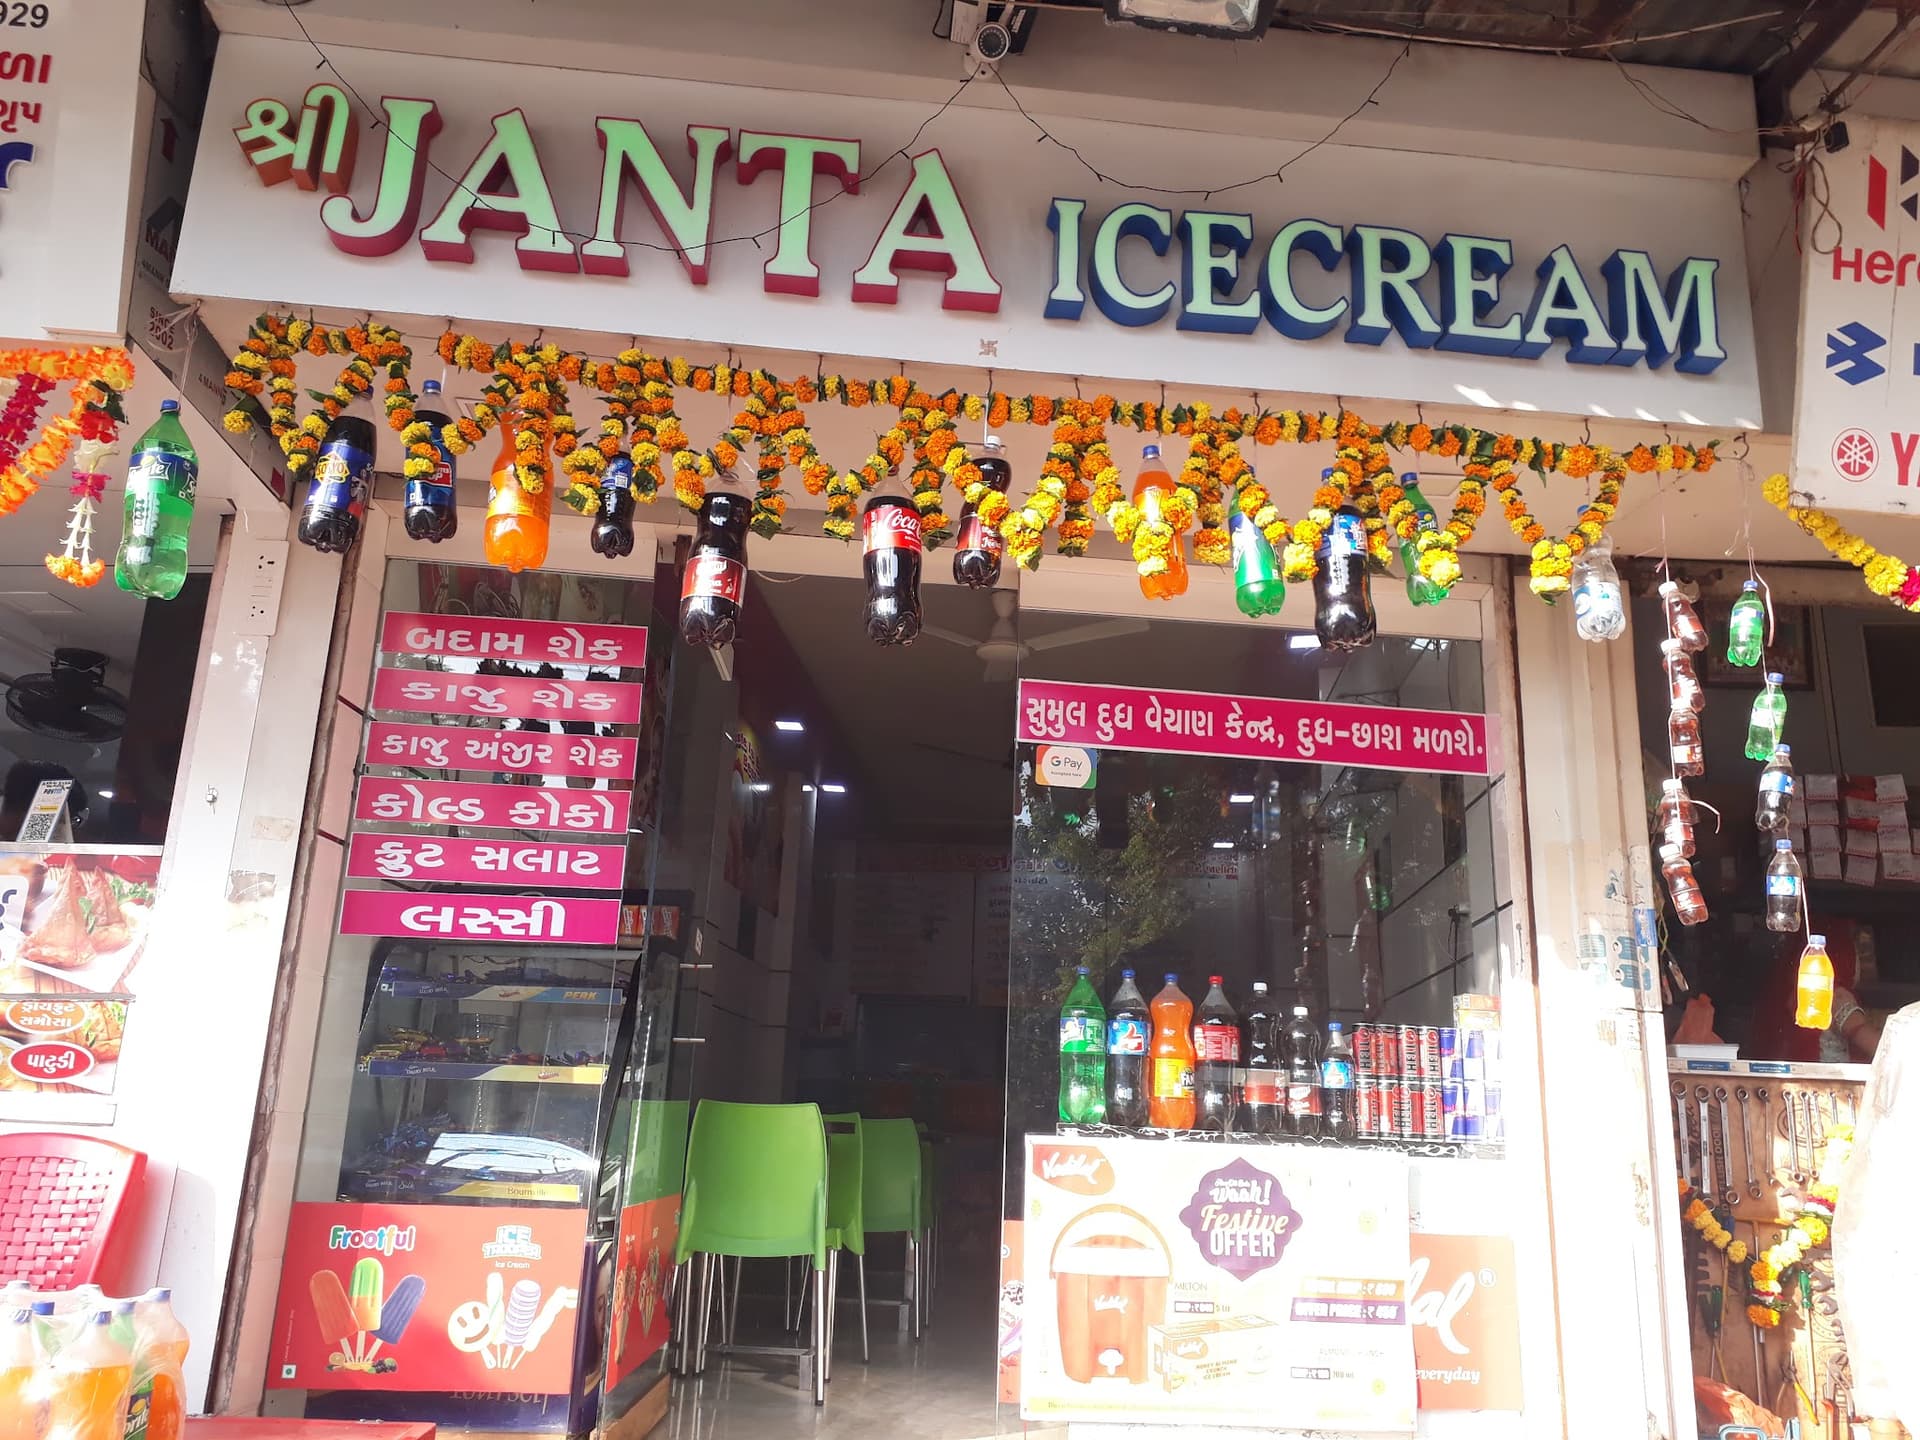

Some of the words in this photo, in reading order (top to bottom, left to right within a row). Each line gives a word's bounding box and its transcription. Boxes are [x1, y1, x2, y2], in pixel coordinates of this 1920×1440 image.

[232, 82, 355, 190] શ્રી
[319, 95, 1002, 314] JANTA
[1044, 197, 1727, 374] ICECREAM
[150, 307, 176, 337] SINCE
[150, 322, 174, 351] 2002
[405, 627, 524, 655] બદામ
[548, 627, 622, 661] શેક
[401, 681, 508, 713] કાજુ
[532, 683, 616, 710] શેક
[1026, 697, 1086, 738] સુમુલ
[1096, 702, 1133, 742] દુધ
[1145, 695, 1213, 737] વેચાણ
[1225, 701, 1284, 749] કેન્દ્ર,
[1297, 717, 1401, 757] દુધ-છાશ
[1413, 719, 1483, 756] મળશે.
[382, 734, 450, 767] કાજુ
[464, 733, 553, 768] અંજીર
[569, 738, 622, 768] શેક
[1050, 755, 1061, 767] G
[1063, 757, 1083, 771] Pay
[371, 784, 485, 822] કોલ્ડ
[509, 791, 614, 829] કોકો
[471, 846, 601, 875] સલાટ
[399, 900, 566, 937] લસ્સી
[563, 991, 598, 1000] PERK
[1201, 1204, 1289, 1234] Festive
[330, 1226, 415, 1255] Frootful
[1210, 1230, 1276, 1257] OFFER
[507, 1261, 530, 1269] Cream
[1174, 1281, 1208, 1291] MILTON
